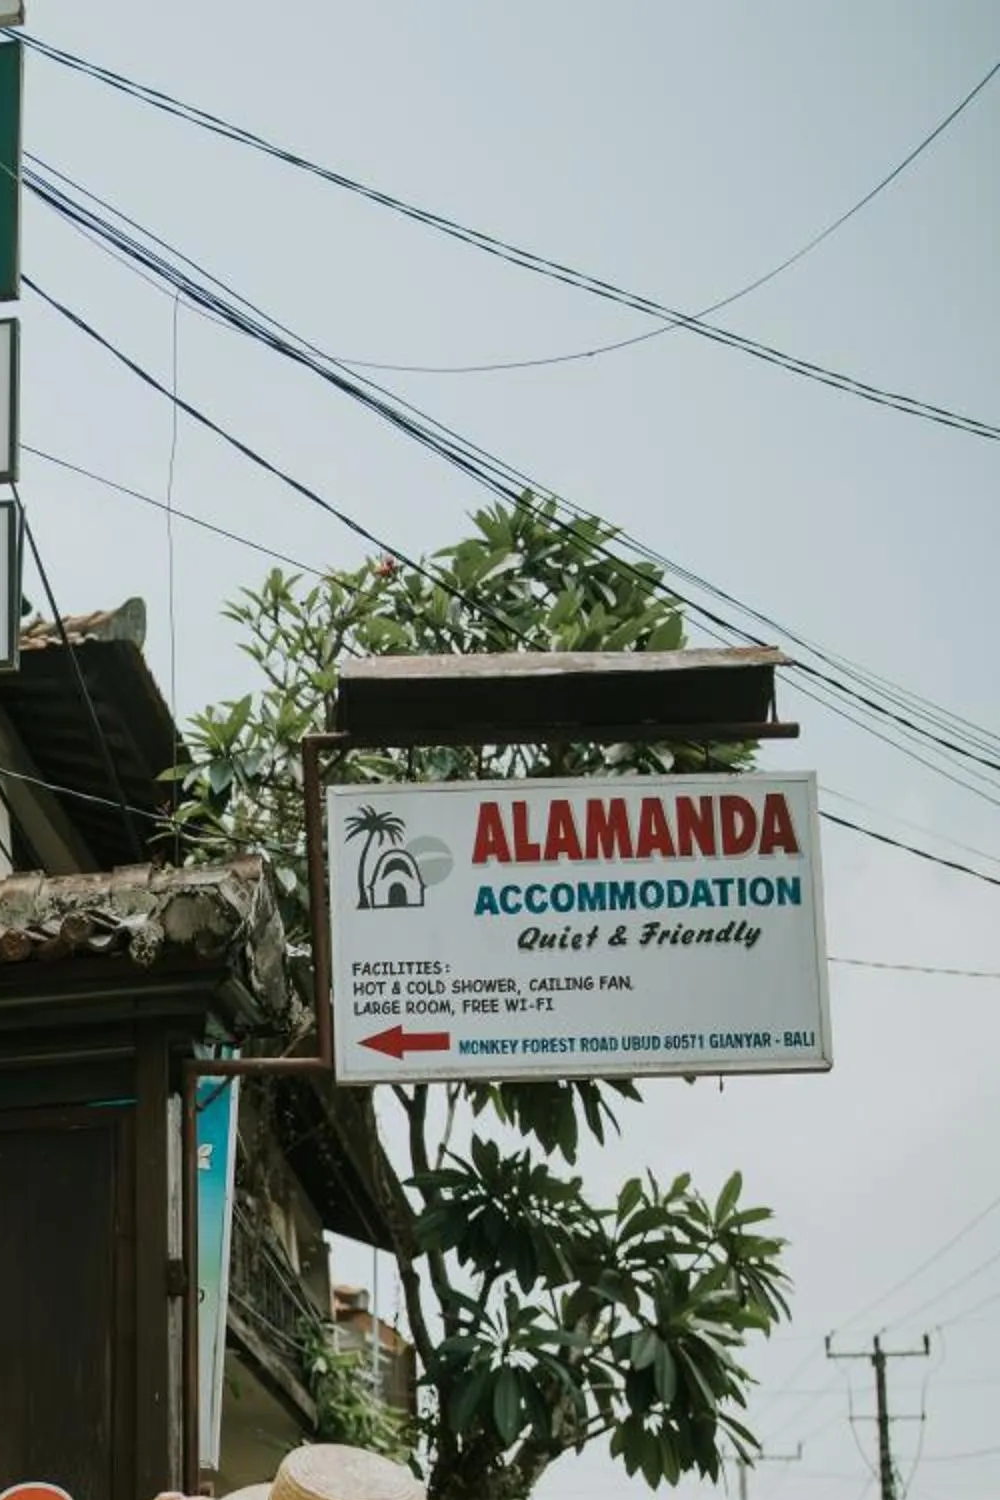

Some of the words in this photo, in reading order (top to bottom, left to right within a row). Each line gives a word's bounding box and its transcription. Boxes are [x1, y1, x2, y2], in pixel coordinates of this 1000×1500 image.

[472, 793, 802, 865] ALAMANDA
[474, 876, 802, 916] ACCOMMODATION
[517, 925, 598, 951] Quiet
[607, 925, 627, 947] &
[639, 920, 762, 949] Friendly
[352, 961, 451, 977] FACILITIES:
[353, 981, 386, 996] HOT
[391, 980, 401, 995] &
[407, 980, 446, 995] COLD
[452, 978, 522, 996] SHOWER,
[529, 976, 595, 992] CAILING
[353, 1001, 400, 1016] LARGE
[406, 1000, 456, 1017] ROOM,
[463, 998, 499, 1013] FREE
[505, 997, 555, 1012] WI-FI
[459, 1039, 518, 1055] MONKEY
[522, 1037, 576, 1053] FOREST
[580, 1035, 619, 1052] ROAD
[621, 1035, 661, 1051] UBUD
[664, 1033, 704, 1049] 80571
[709, 1032, 771, 1049] GIANYAR
[783, 1031, 815, 1048] BALI
